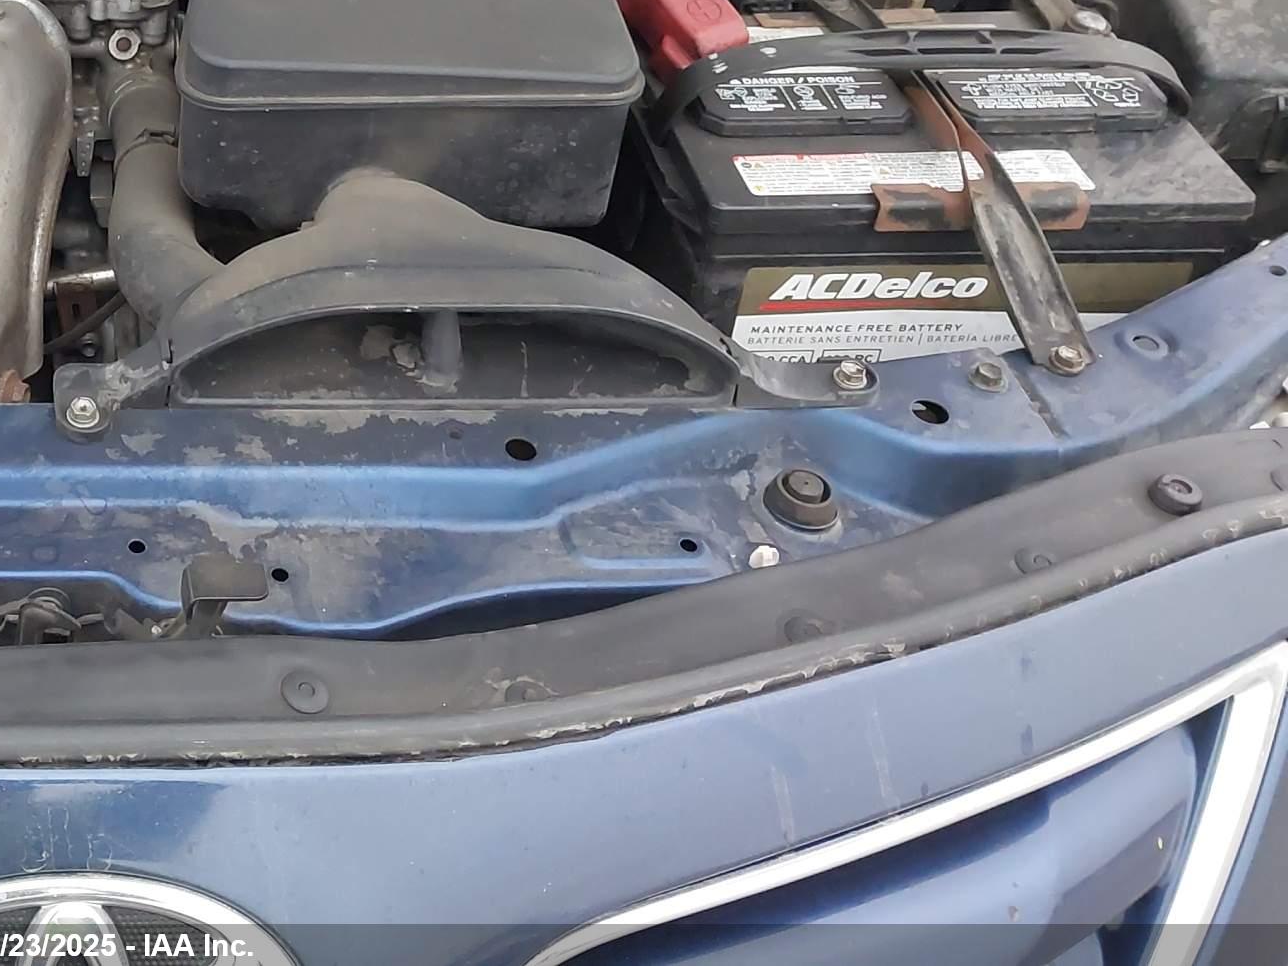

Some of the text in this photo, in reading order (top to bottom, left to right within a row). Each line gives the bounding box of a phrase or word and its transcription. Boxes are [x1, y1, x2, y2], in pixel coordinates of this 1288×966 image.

[742, 76, 796, 84] DANGER
[806, 75, 855, 83] POISON
[768, 271, 988, 300] ACDelco
[750, 323, 965, 334] MAINTENANCE FREE BATTERY
[747, 334, 915, 345] BATTERIE SANS ENTRETIEN
[982, 333, 1017, 343] LIBRE
